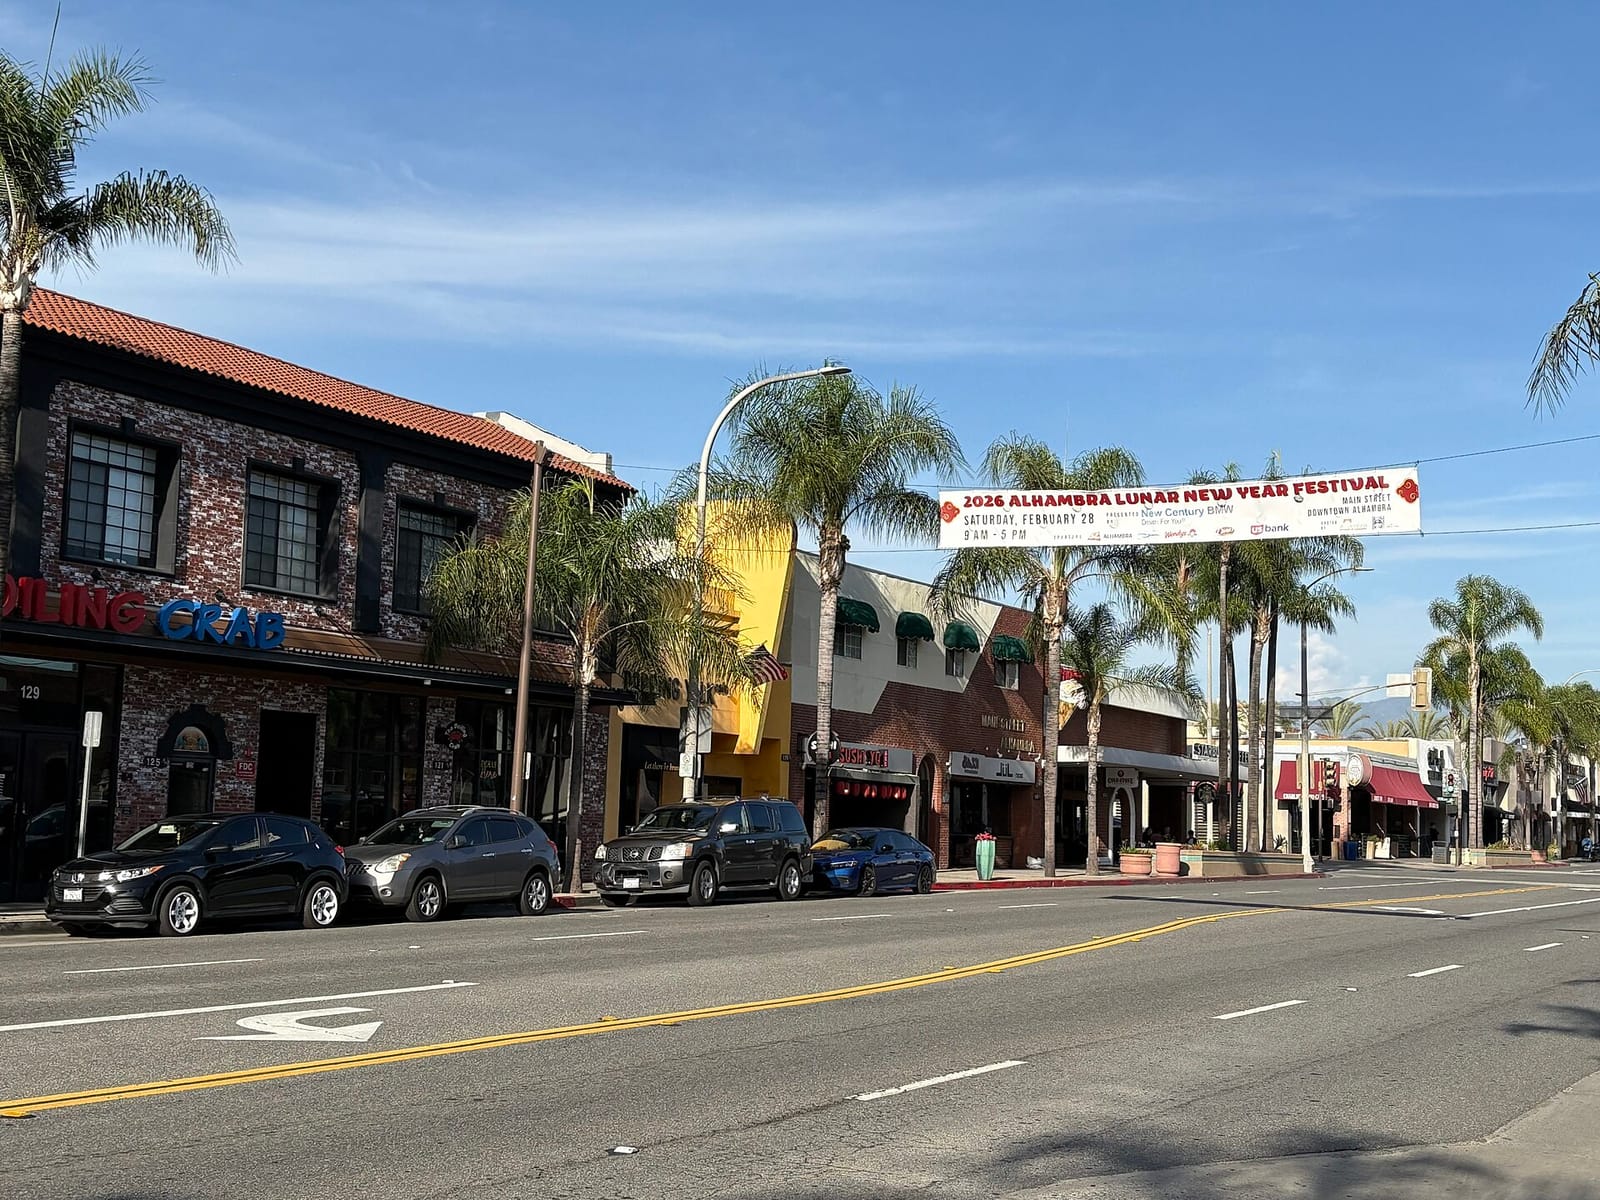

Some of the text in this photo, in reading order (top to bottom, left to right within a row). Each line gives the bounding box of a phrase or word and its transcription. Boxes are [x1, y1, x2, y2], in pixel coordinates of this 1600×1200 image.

[963, 475, 1390, 508] 2026 ALHAMBRA LUNAR NEW YEAR FESTIVAL
[1342, 493, 1391, 505] MAIN STREET
[1141, 504, 1234, 519] New Century BMW
[1307, 503, 1392, 518] DOWNTOWN ALHAMBRA
[964, 512, 1095, 526] SATURDAY, FEBRUARY 28
[1264, 523, 1289, 533] bank
[964, 530, 970, 541] 9
[973, 530, 988, 541] AM
[1000, 529, 1007, 541] 5
[1012, 529, 1027, 540] PM
[157, 600, 286, 649] CRAB
[20, 685, 41, 700] 129
[810, 740, 838, 751] SHI
[146, 758, 160, 767] 125
[239, 762, 253, 771] FDC
